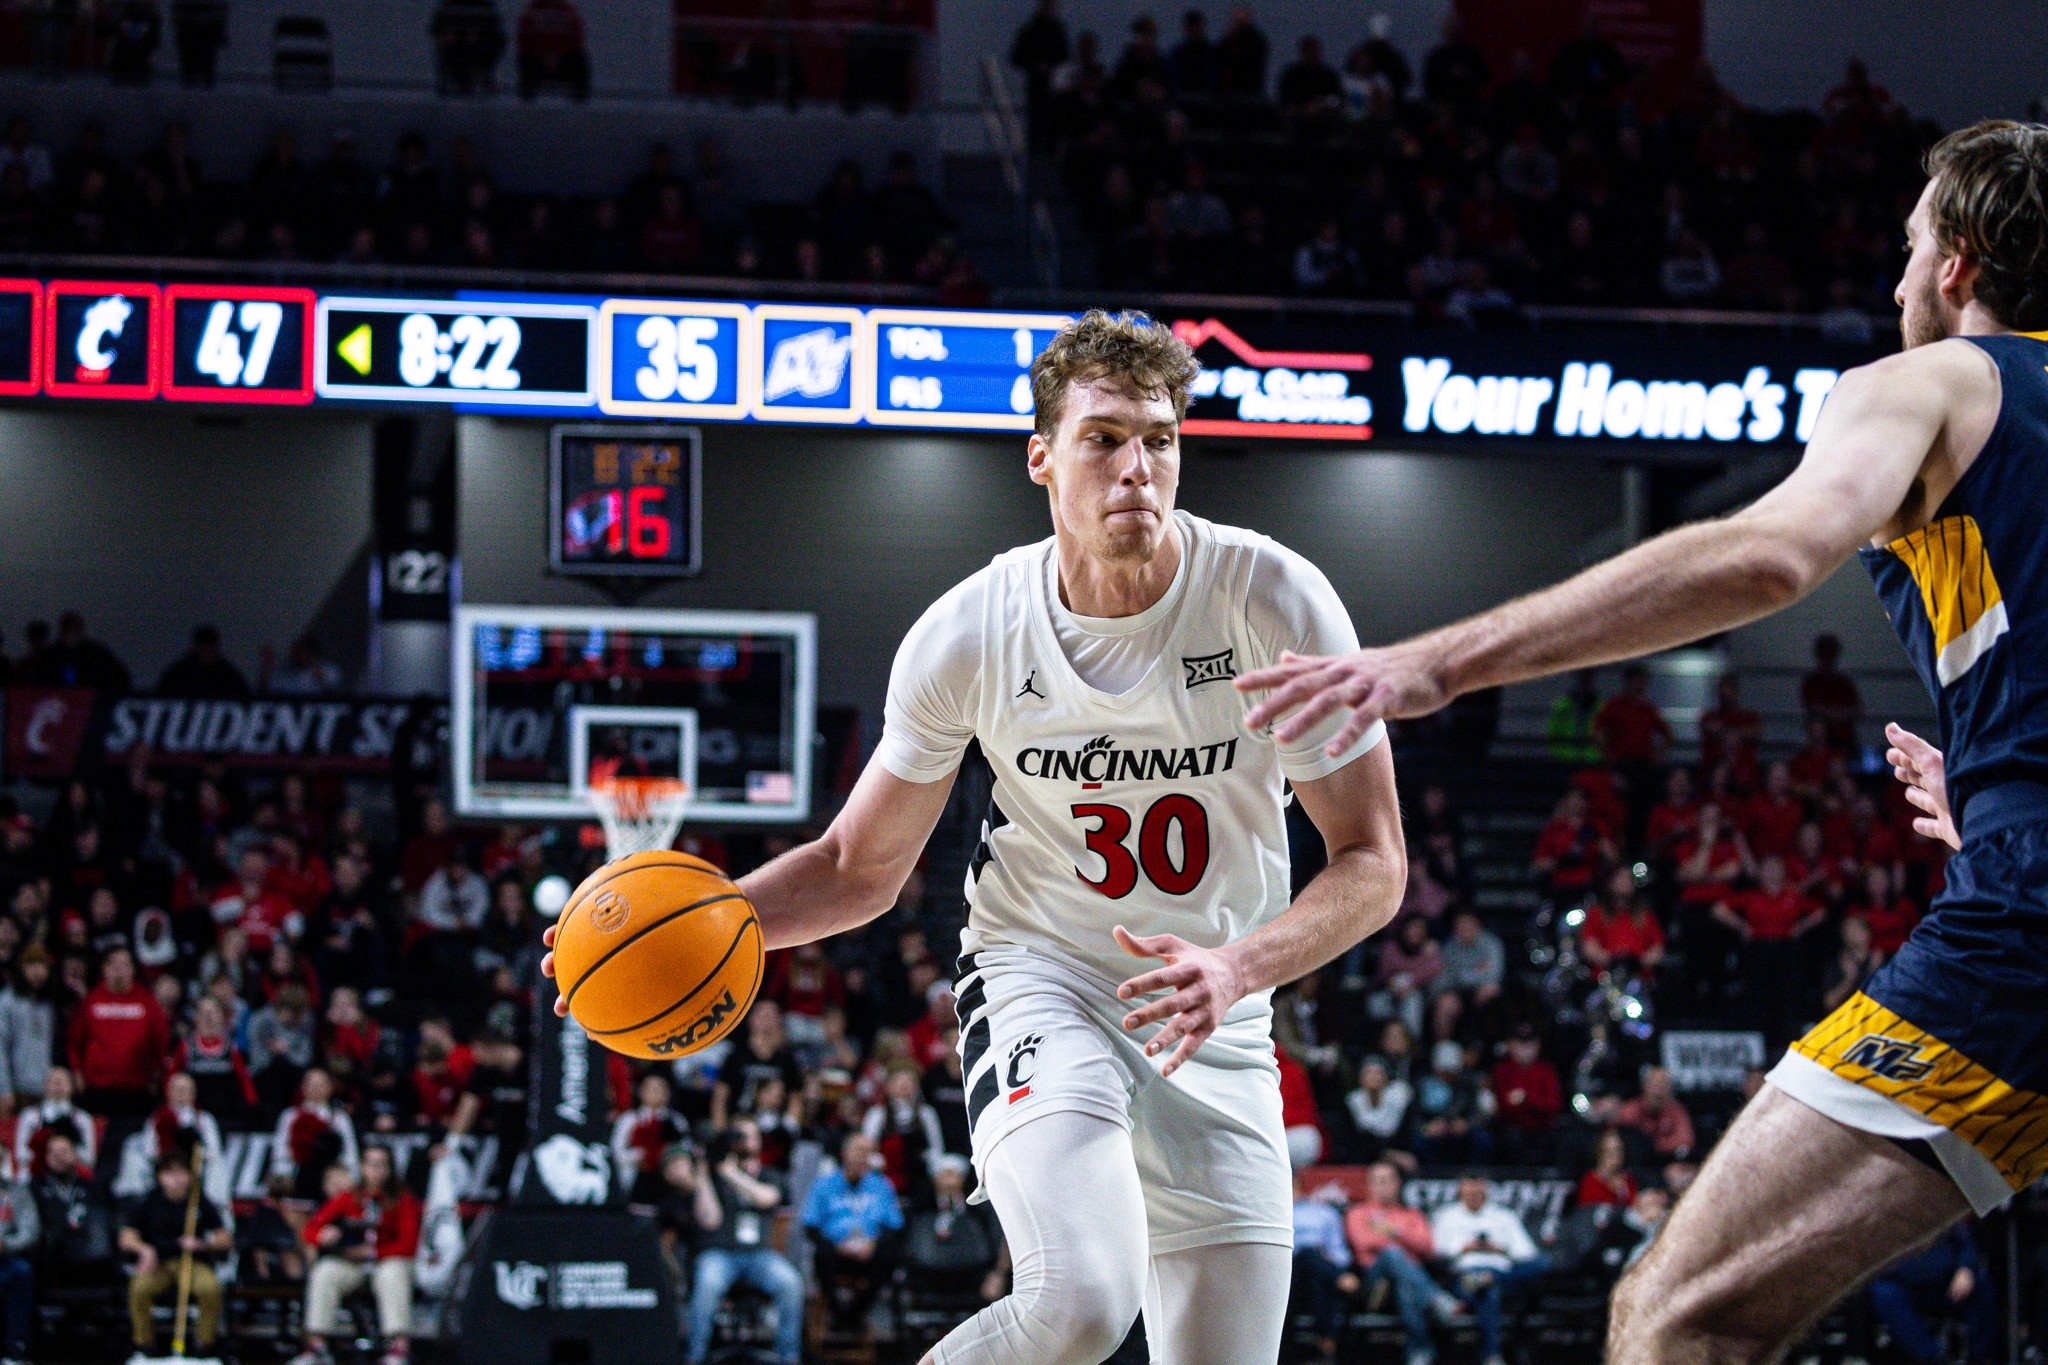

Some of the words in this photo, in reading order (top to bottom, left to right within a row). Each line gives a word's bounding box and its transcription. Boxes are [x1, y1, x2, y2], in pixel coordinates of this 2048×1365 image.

[197, 301, 283, 386] 47
[400, 313, 521, 390] 8:22
[635, 316, 718, 402] 35
[1012, 328, 1034, 369] 1
[1401, 356, 1554, 436] Your
[1553, 361, 1788, 442] Home's
[103, 696, 353, 755] STUDENT
[1016, 735, 1240, 782] CINCINNATI
[1071, 793, 1210, 900] 30
[646, 988, 737, 1054] NCAA
